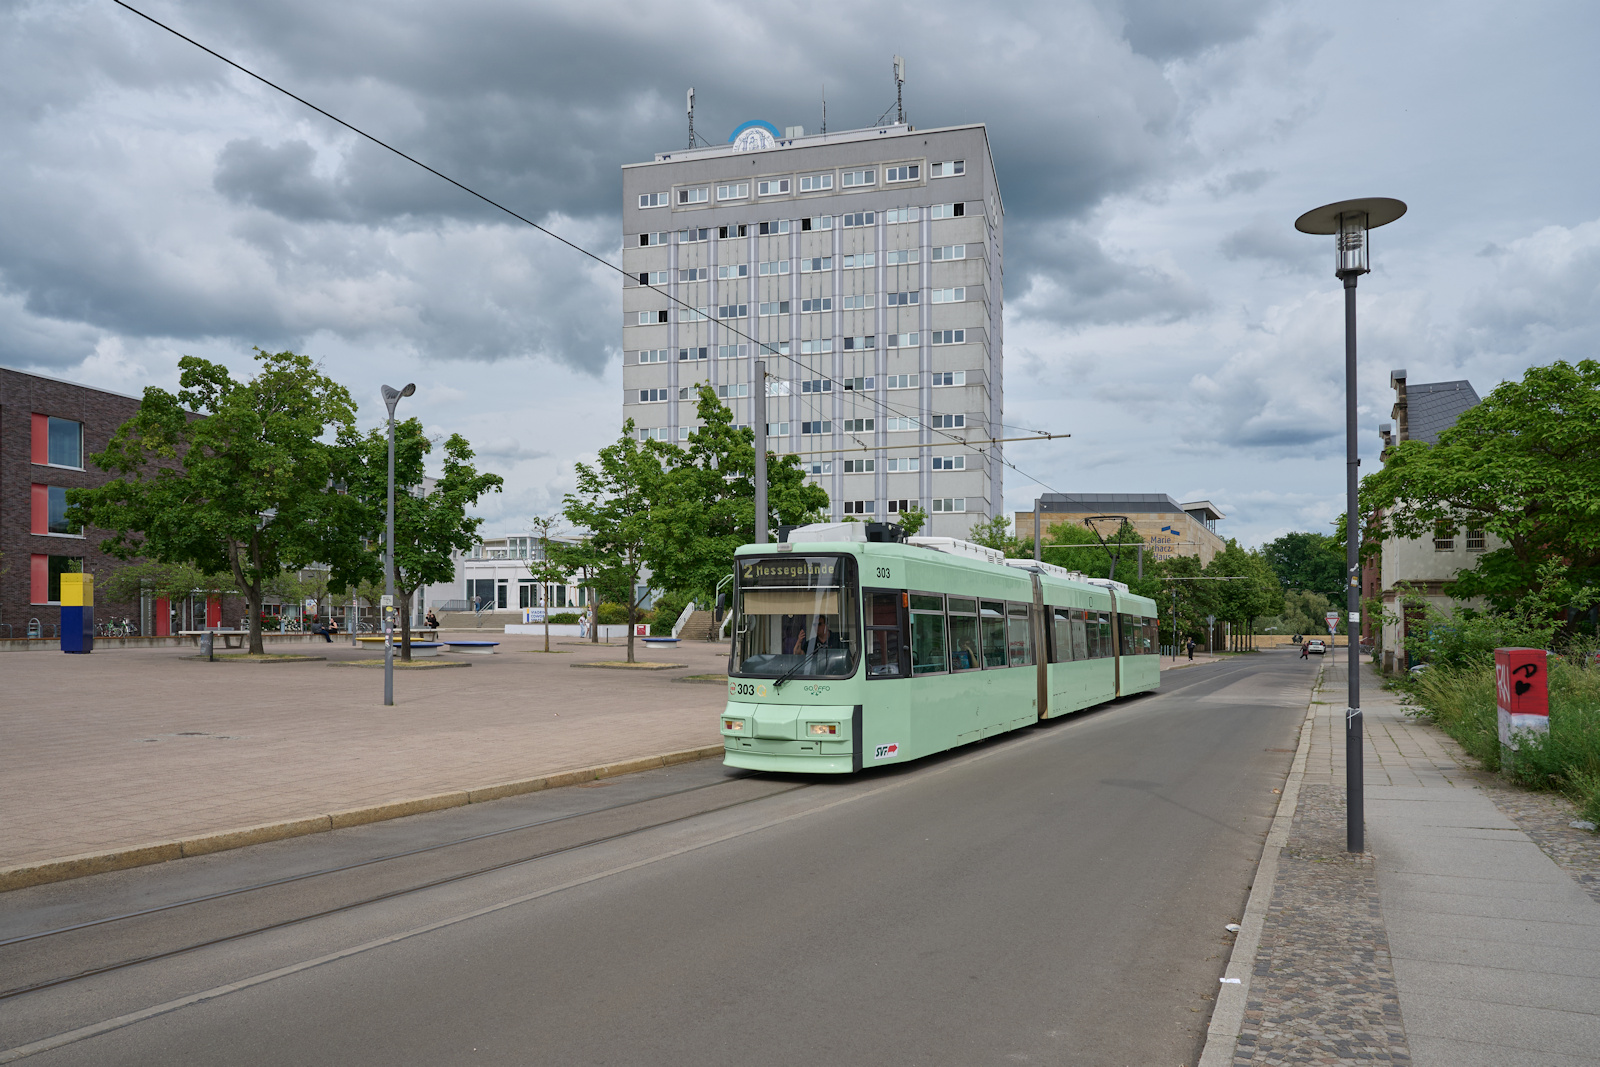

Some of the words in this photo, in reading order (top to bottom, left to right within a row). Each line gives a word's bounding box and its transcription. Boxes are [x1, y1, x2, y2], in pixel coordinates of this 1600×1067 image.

[1150, 536, 1172, 544] Marie
[1153, 552, 1171, 561] Haus
[743, 564, 754, 579] 2
[756, 564, 835, 577] Messegelände
[876, 566, 891, 579] 303
[737, 683, 755, 696] 303
[876, 746, 888, 757] SVF
